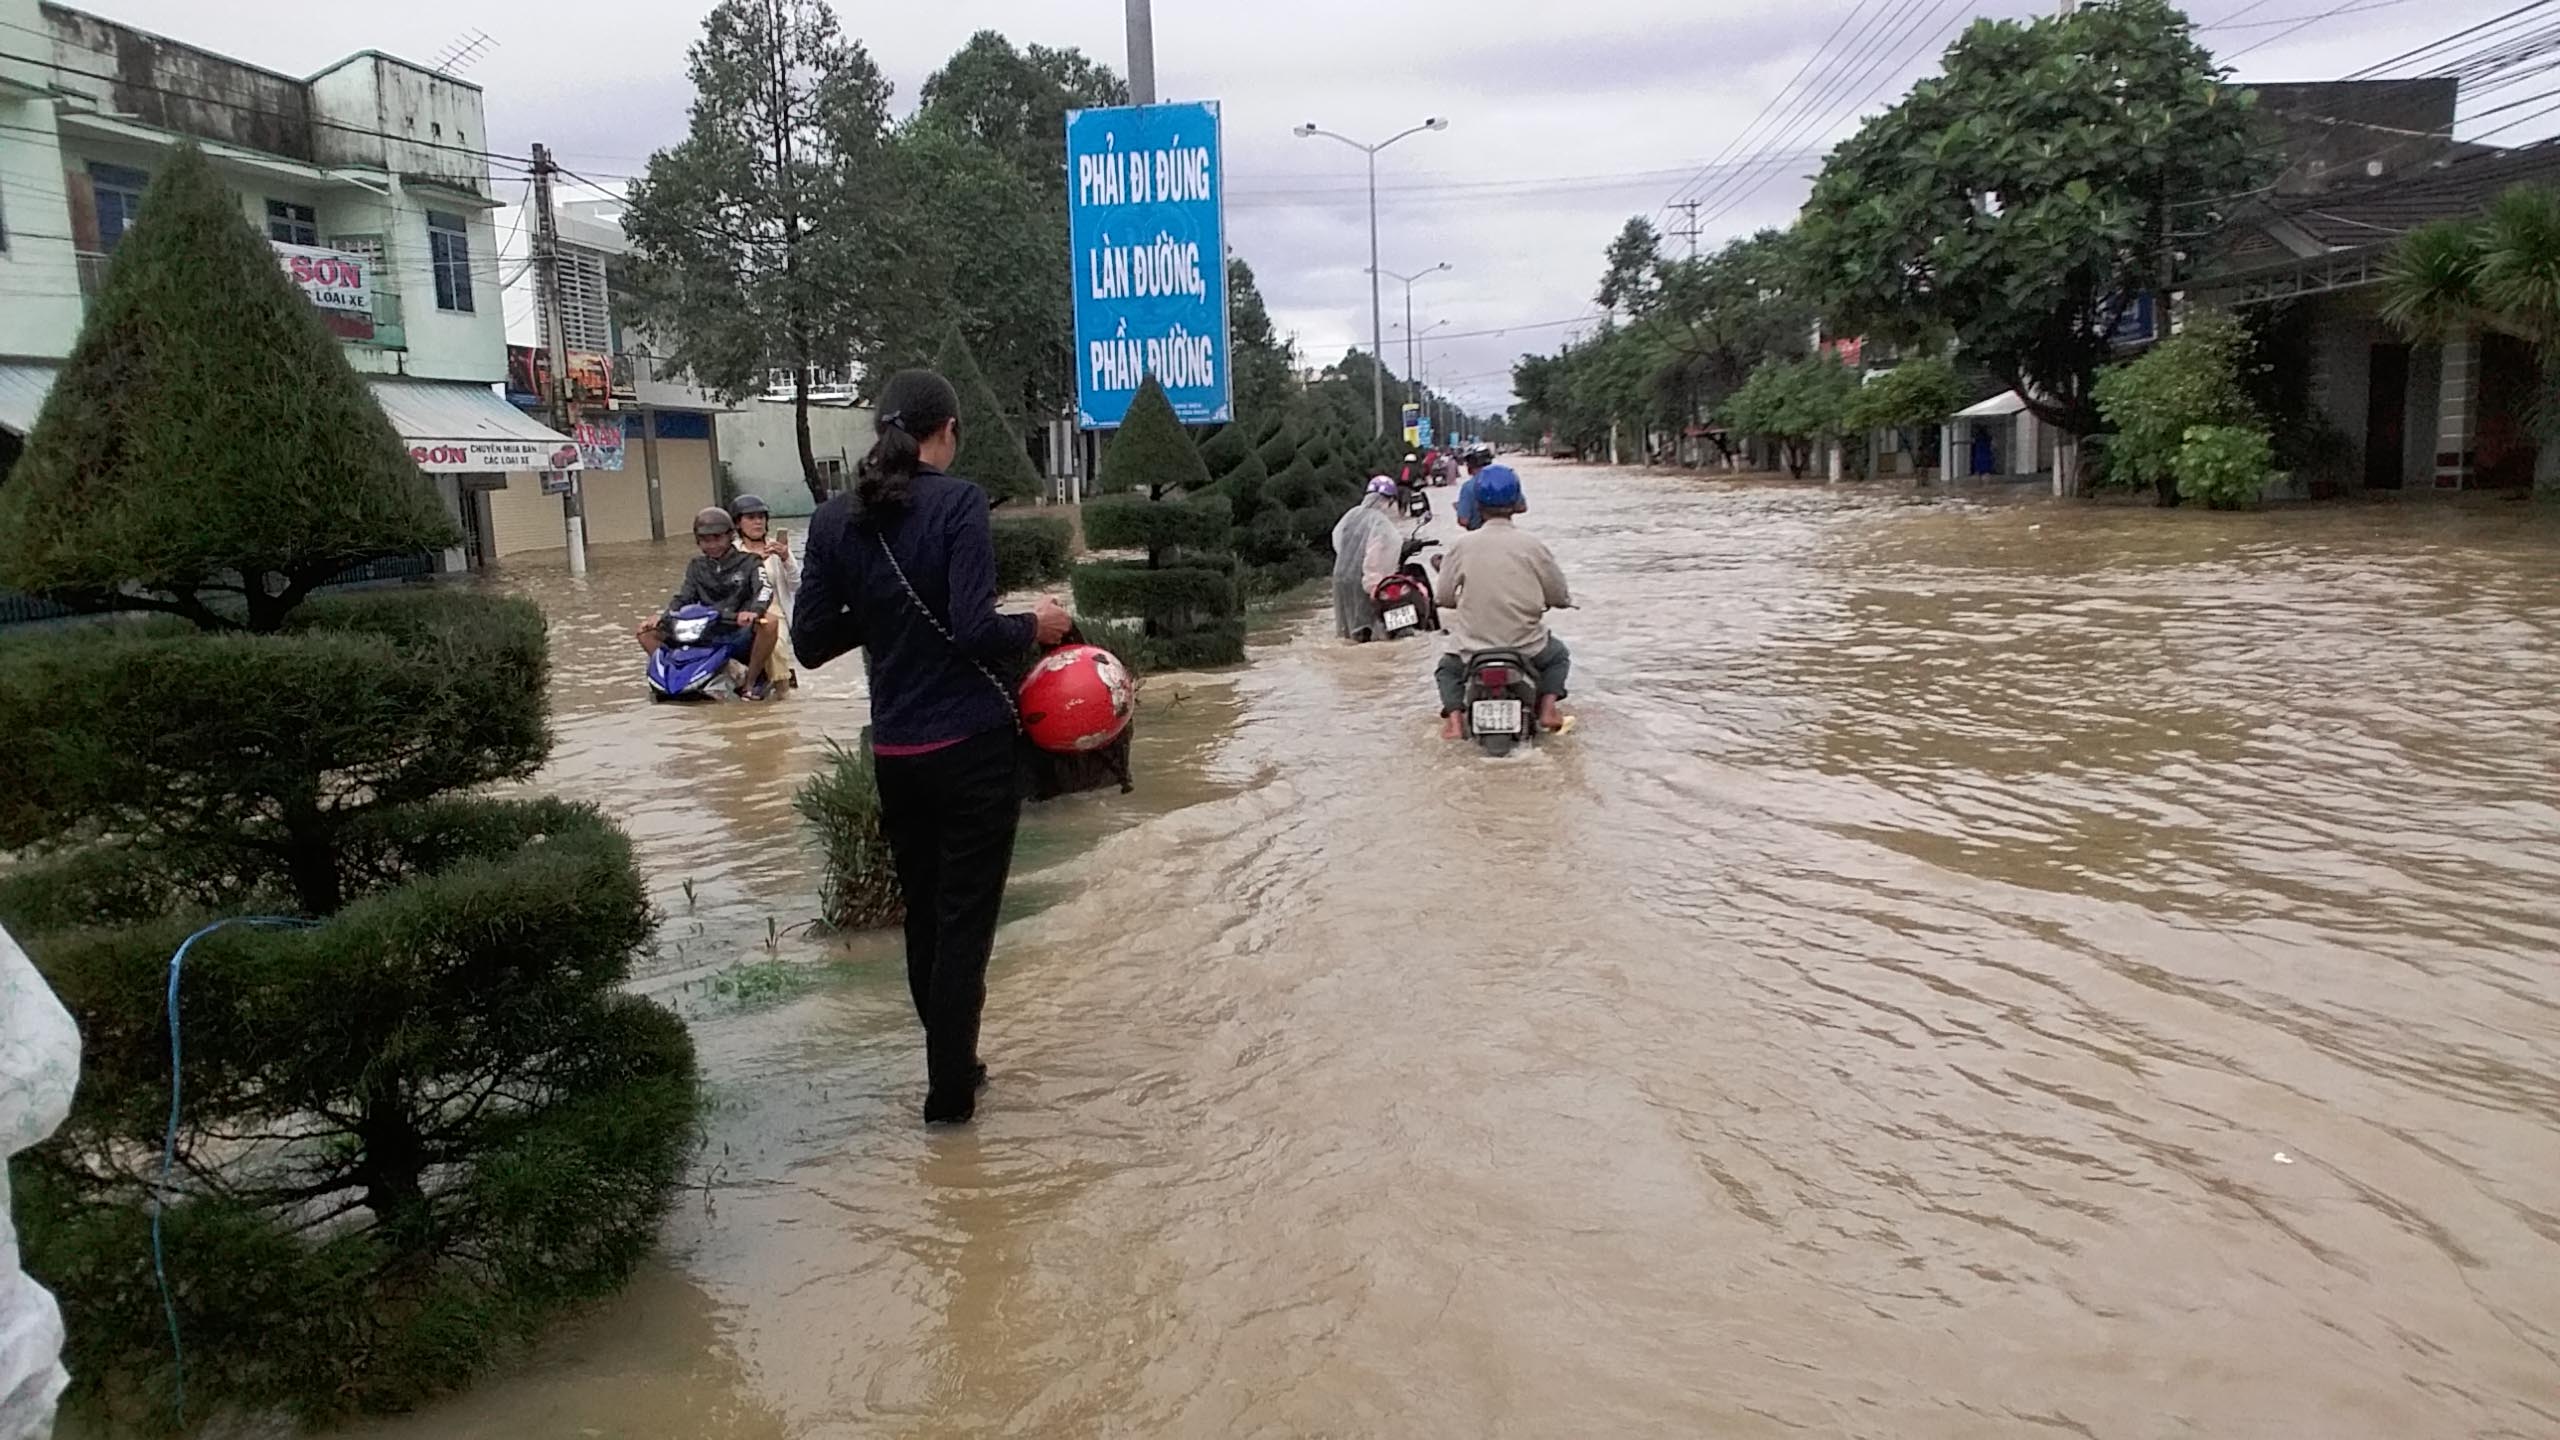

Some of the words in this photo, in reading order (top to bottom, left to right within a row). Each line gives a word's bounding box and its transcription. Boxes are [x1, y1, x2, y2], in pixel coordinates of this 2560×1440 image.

[1079, 131, 1126, 207] PHẢI
[1129, 150, 1151, 204] ĐI
[1155, 133, 1210, 202] ĐÚNG
[350, 294, 366, 308] XE
[1090, 232, 1130, 300] LÀN
[1133, 229, 1206, 305] ĐƯỜNG,
[1090, 317, 1143, 391] PHẦN
[1147, 322, 1214, 389] ĐƯỜNG
